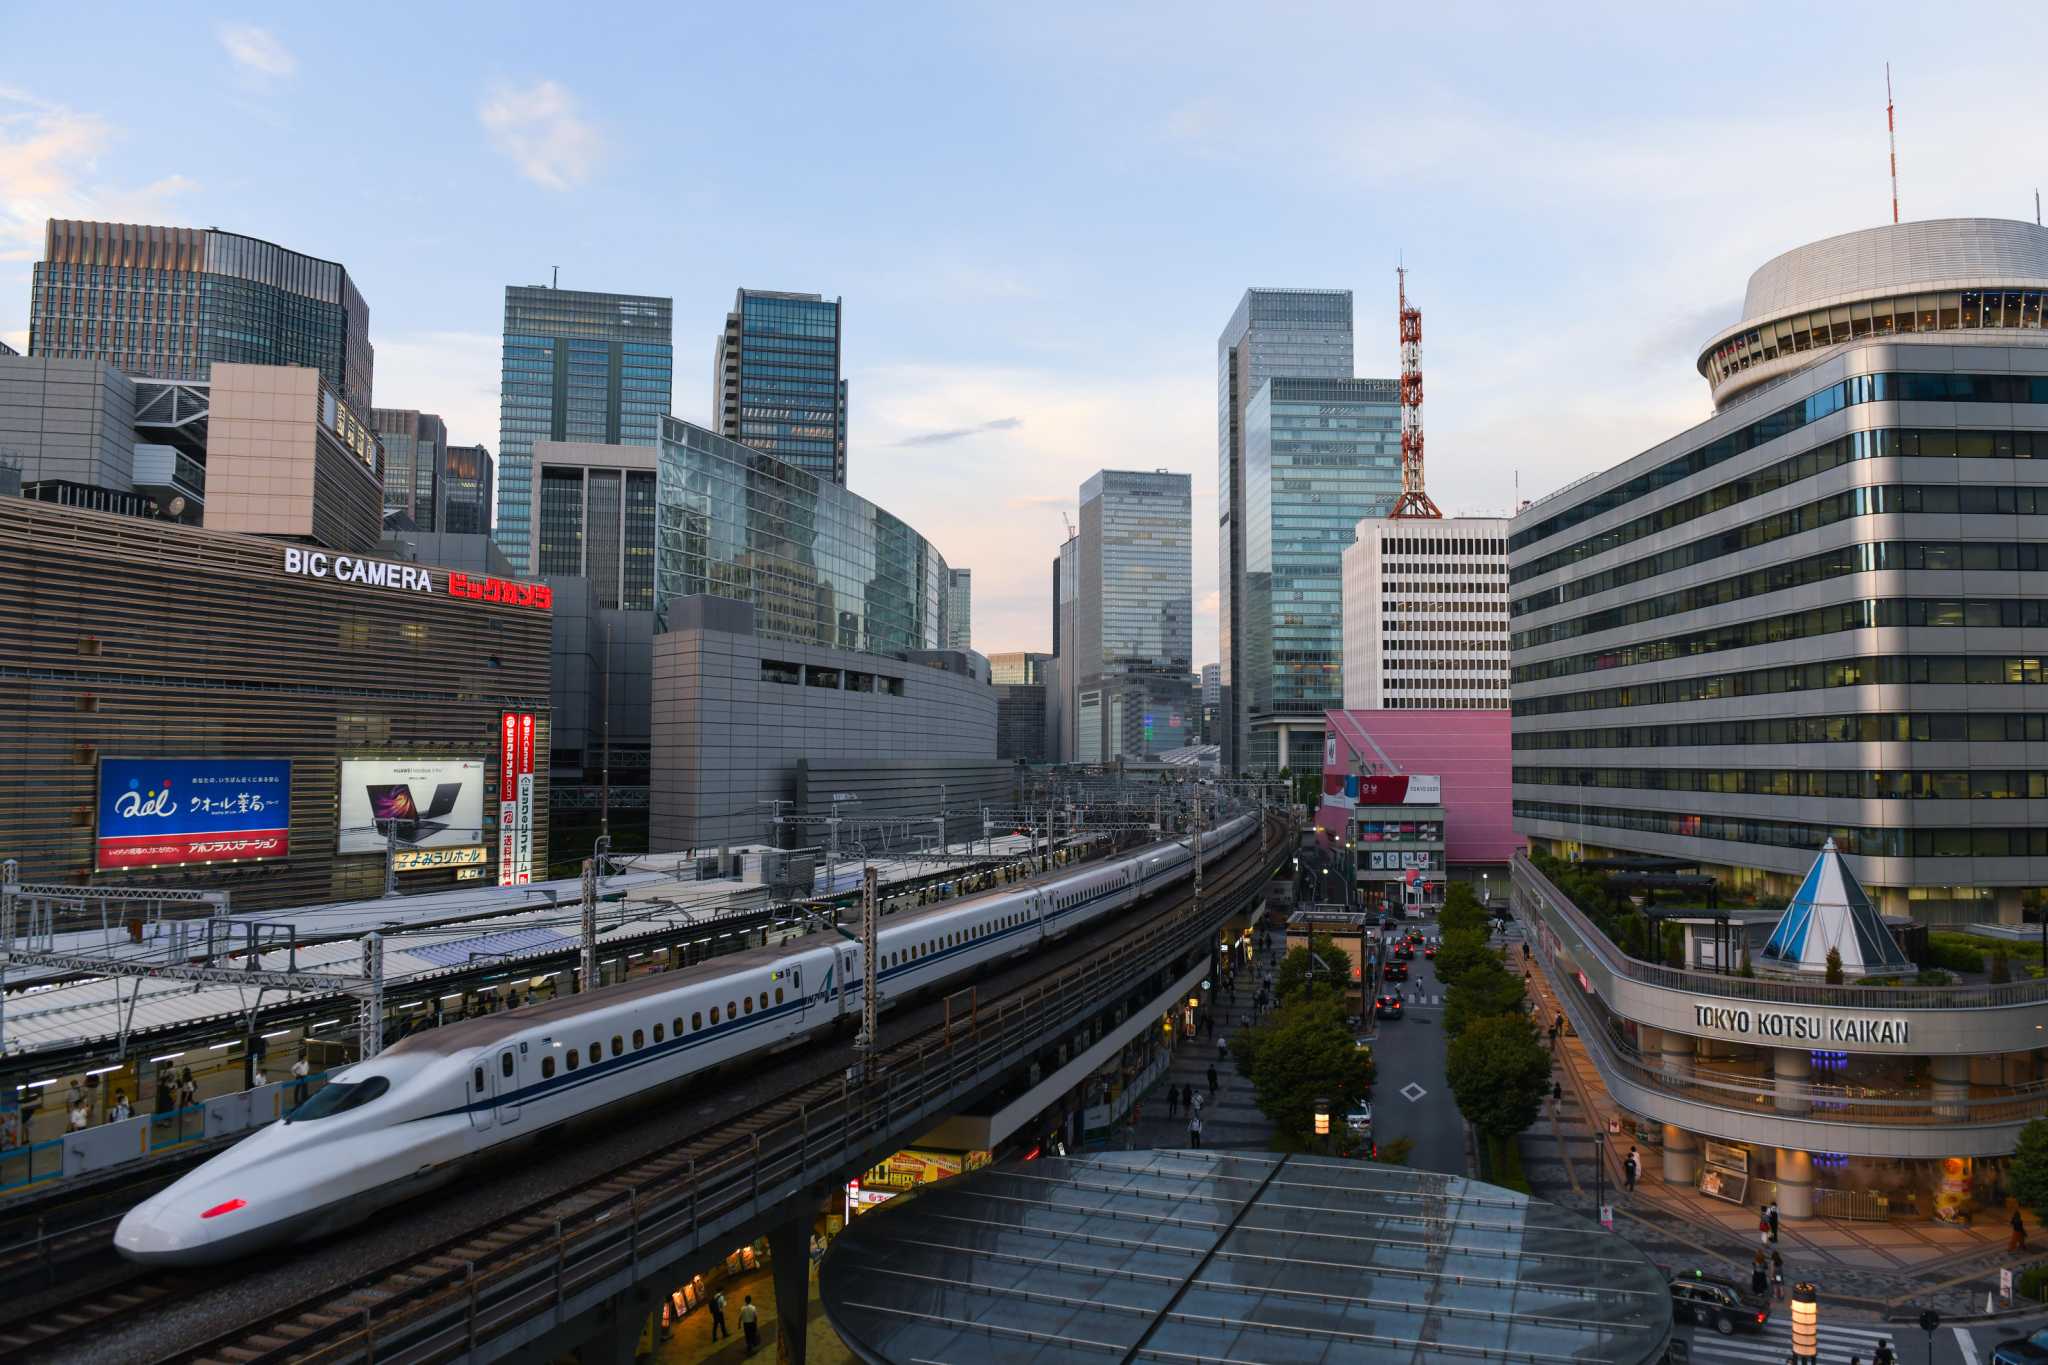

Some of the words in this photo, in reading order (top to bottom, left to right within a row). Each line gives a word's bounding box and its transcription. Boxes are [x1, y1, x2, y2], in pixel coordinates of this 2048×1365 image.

[284, 547, 327, 577] BIC
[335, 556, 432, 592] CAMERA
[448, 570, 553, 609] ビックカメラ
[190, 792, 264, 814] クオール薬局
[410, 849, 480, 868] よみうりホール
[1694, 1004, 1750, 1033] TOKYO
[1757, 1012, 1821, 1040] KOTSU
[1829, 1018, 1909, 1044] KAIKAN
